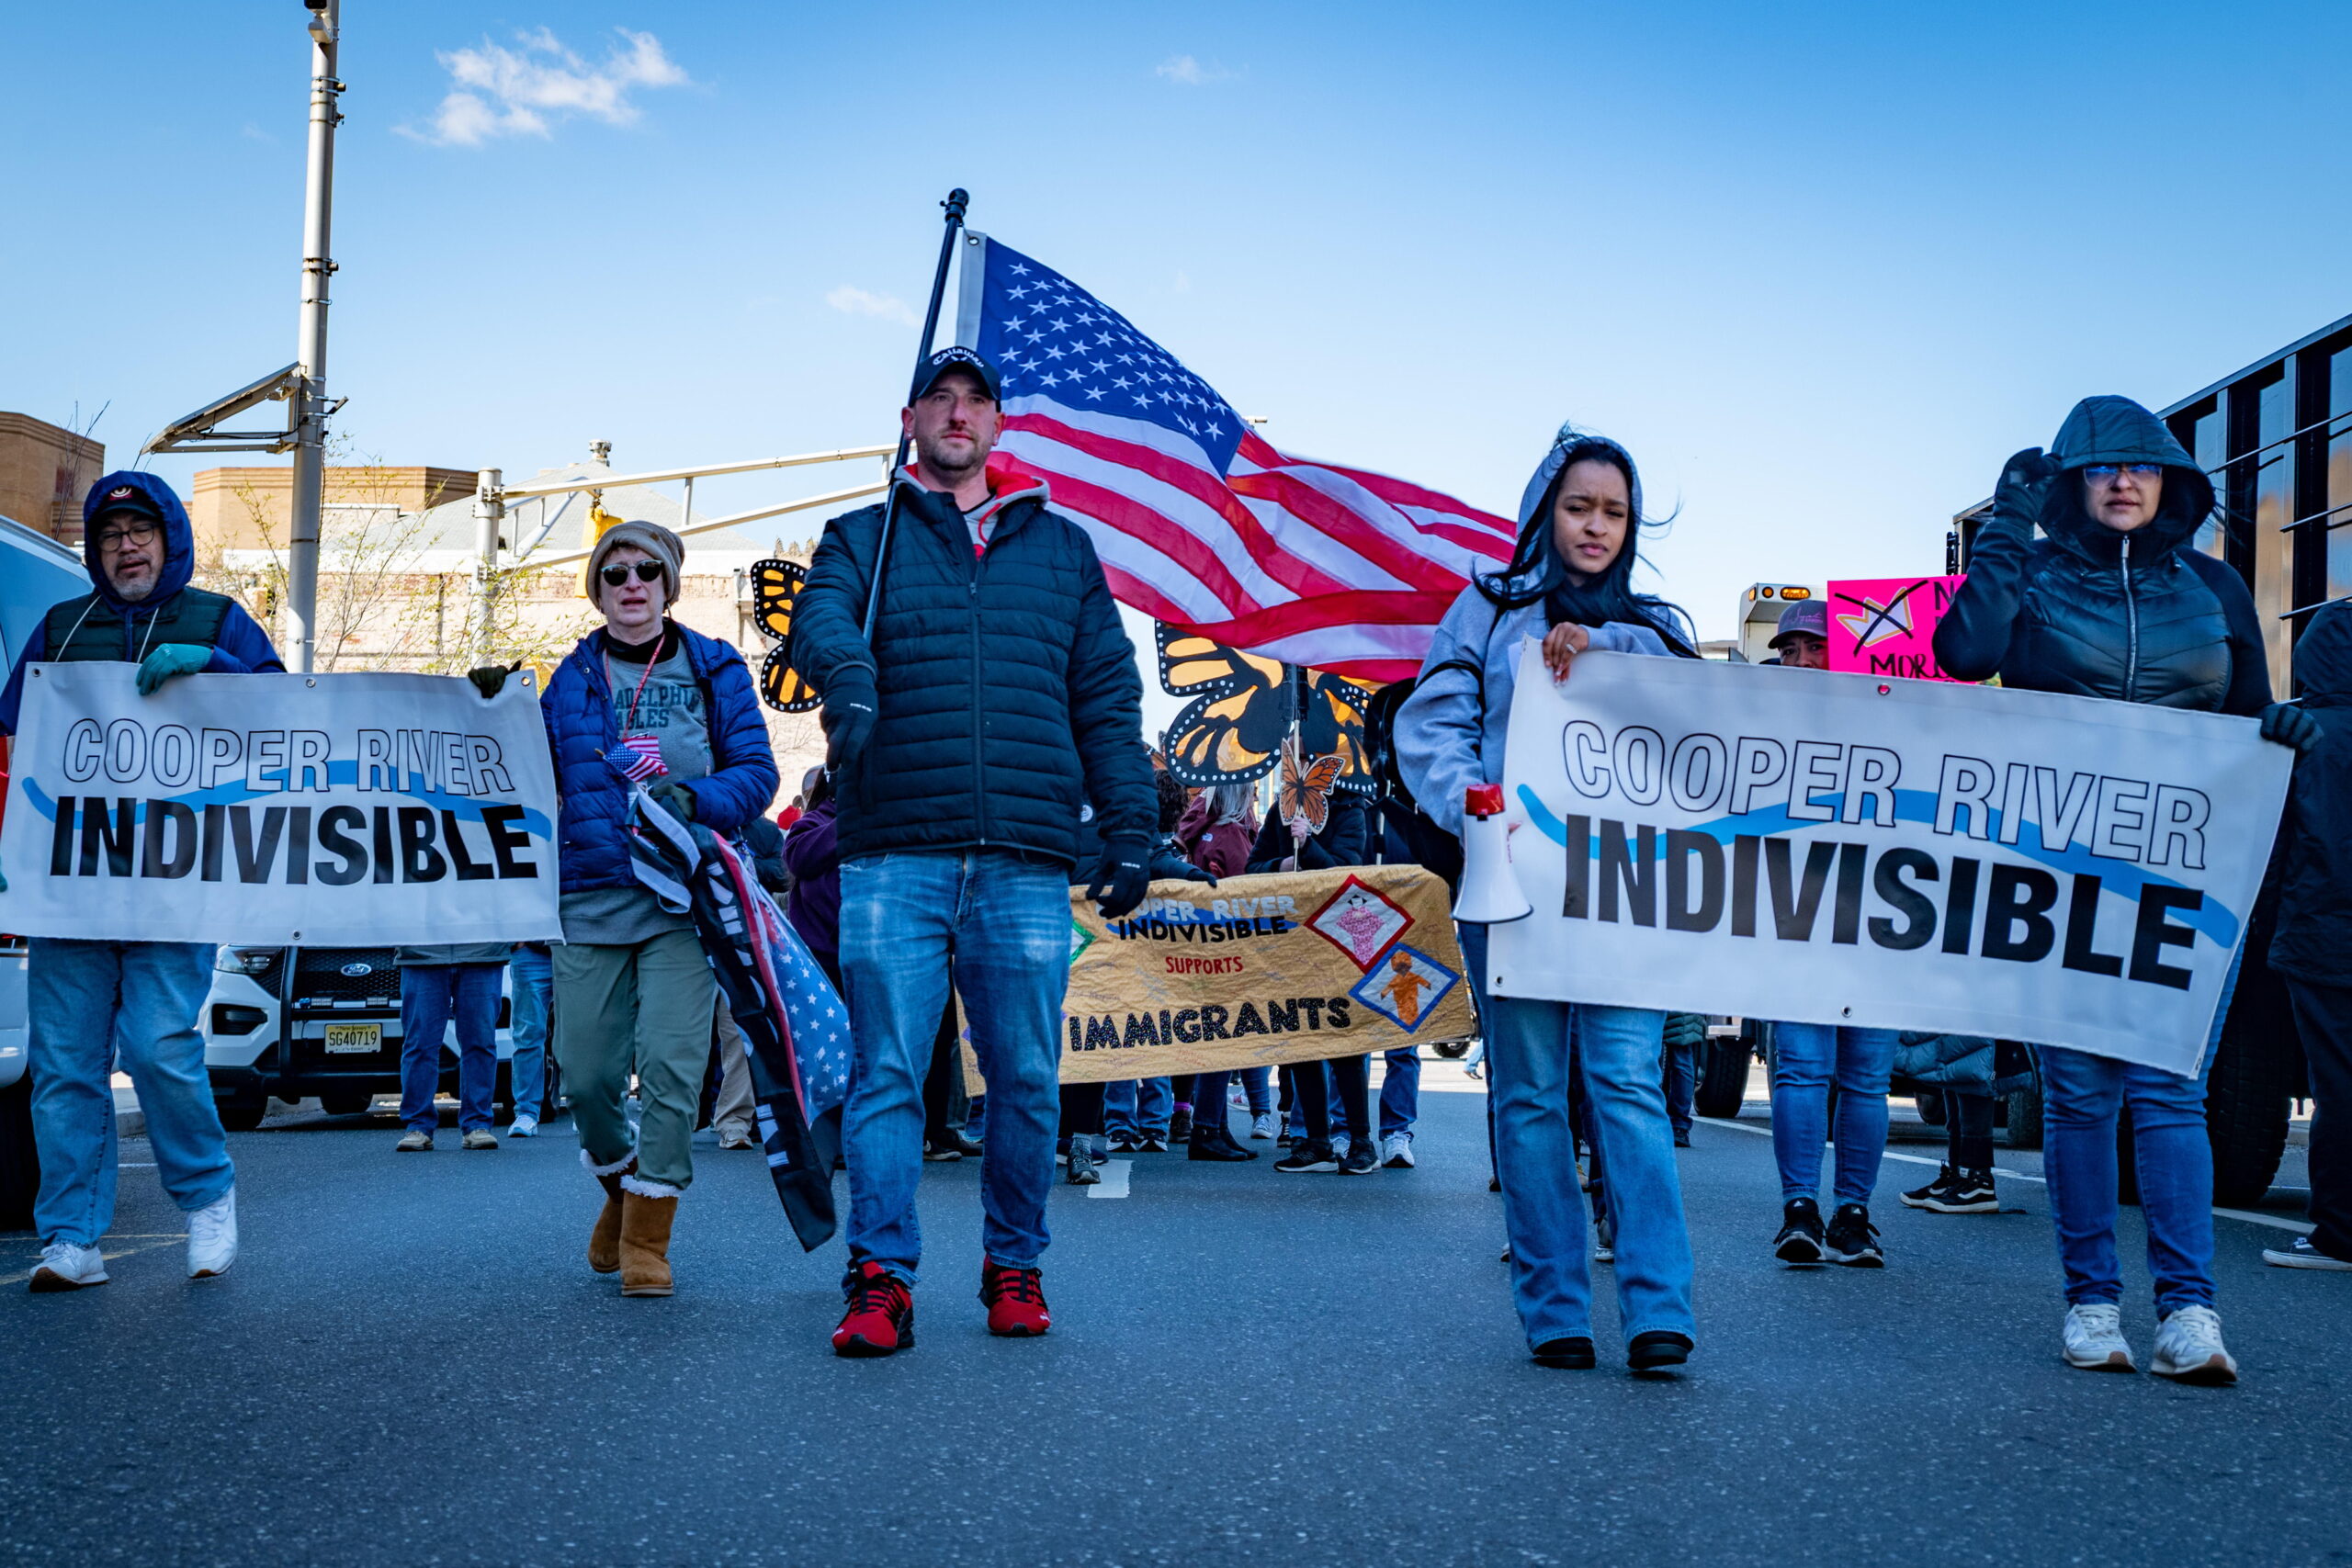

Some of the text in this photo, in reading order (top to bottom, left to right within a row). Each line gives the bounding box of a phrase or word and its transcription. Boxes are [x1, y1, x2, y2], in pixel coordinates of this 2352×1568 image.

[933, 348, 985, 367] Callaway
[614, 685, 700, 713] ADELPHIA
[616, 708, 670, 730] AGLES
[63, 717, 516, 796] COOPER RIVER
[1562, 718, 2211, 870] COOPER RIVER
[50, 795, 539, 886] INDIVISIBLE
[1096, 895, 1299, 922] OPER RIVER
[1563, 813, 2205, 991] INDIVISIBLE
[1118, 915, 1288, 943] INDIVISIBLE
[1164, 955, 1244, 975] SUPPORTS
[329, 1031, 377, 1046] SG40719
[1069, 997, 1351, 1052] IMMIGRANTS
